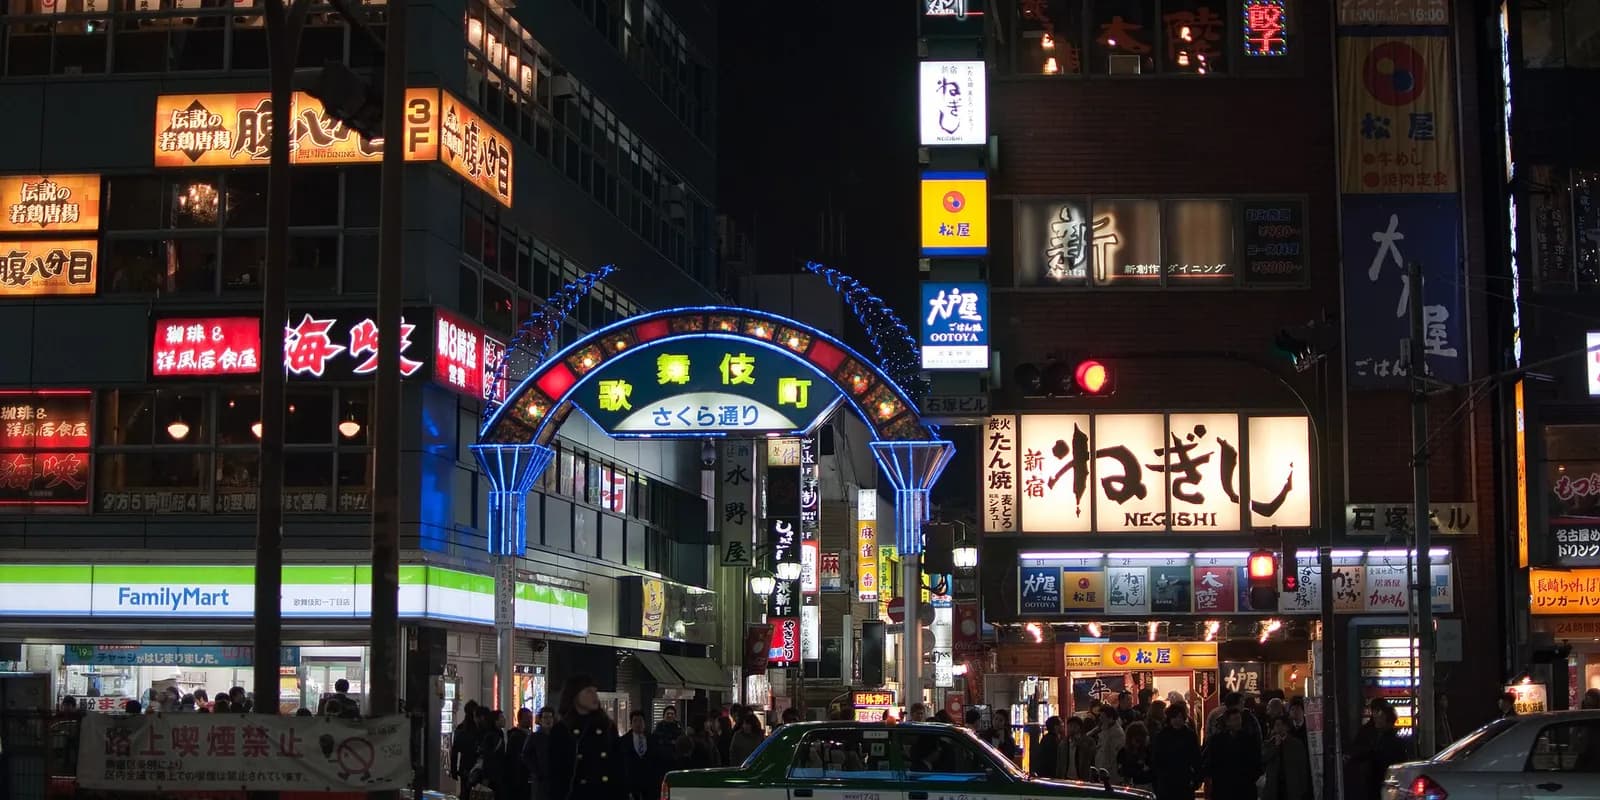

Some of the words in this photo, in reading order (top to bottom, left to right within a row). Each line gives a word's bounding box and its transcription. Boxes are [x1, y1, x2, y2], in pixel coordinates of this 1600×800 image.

[1248, 4, 1283, 51] 餃子
[936, 76, 963, 135] ねぎし
[171, 109, 222, 129] 伝説の
[407, 98, 431, 153] 3F
[1361, 112, 1435, 140] 松屋
[159, 130, 232, 151] 若鶏唐揚
[463, 120, 509, 198] 腹八分目
[21, 182, 71, 202] 伝説の
[9, 203, 80, 224] 若鶏唐揚
[939, 222, 970, 237] 松屋
[0, 249, 94, 286] 腹八分目
[1124, 264, 1160, 273] 新創作
[1167, 263, 1227, 273] ダイニング
[1368, 213, 1457, 357] 大屋
[927, 287, 982, 326] 大戸屋
[930, 332, 979, 342] OOTOYA
[156, 348, 257, 370] 洋風居食屋
[1354, 357, 1434, 378] ごはん
[598, 352, 812, 412] 歌舞伎町
[652, 405, 760, 427] さくら通り
[988, 432, 1012, 490] たん焼
[1023, 448, 1045, 498] 新宿
[1047, 421, 1293, 519] ねぎし
[1001, 494, 1012, 529] 麦とろ
[1123, 511, 1217, 527] NEGISHI
[860, 526, 875, 587] 麻雀一番
[1023, 572, 1058, 597] 大戸屋
[1073, 592, 1096, 603] 松屋
[118, 587, 229, 611] FamilyMart
[783, 620, 795, 660] やきとり
[95, 653, 220, 665] チャージがはじまりました。
[1135, 648, 1171, 664] 松屋
[105, 725, 303, 759] 路上喫煙禁止
